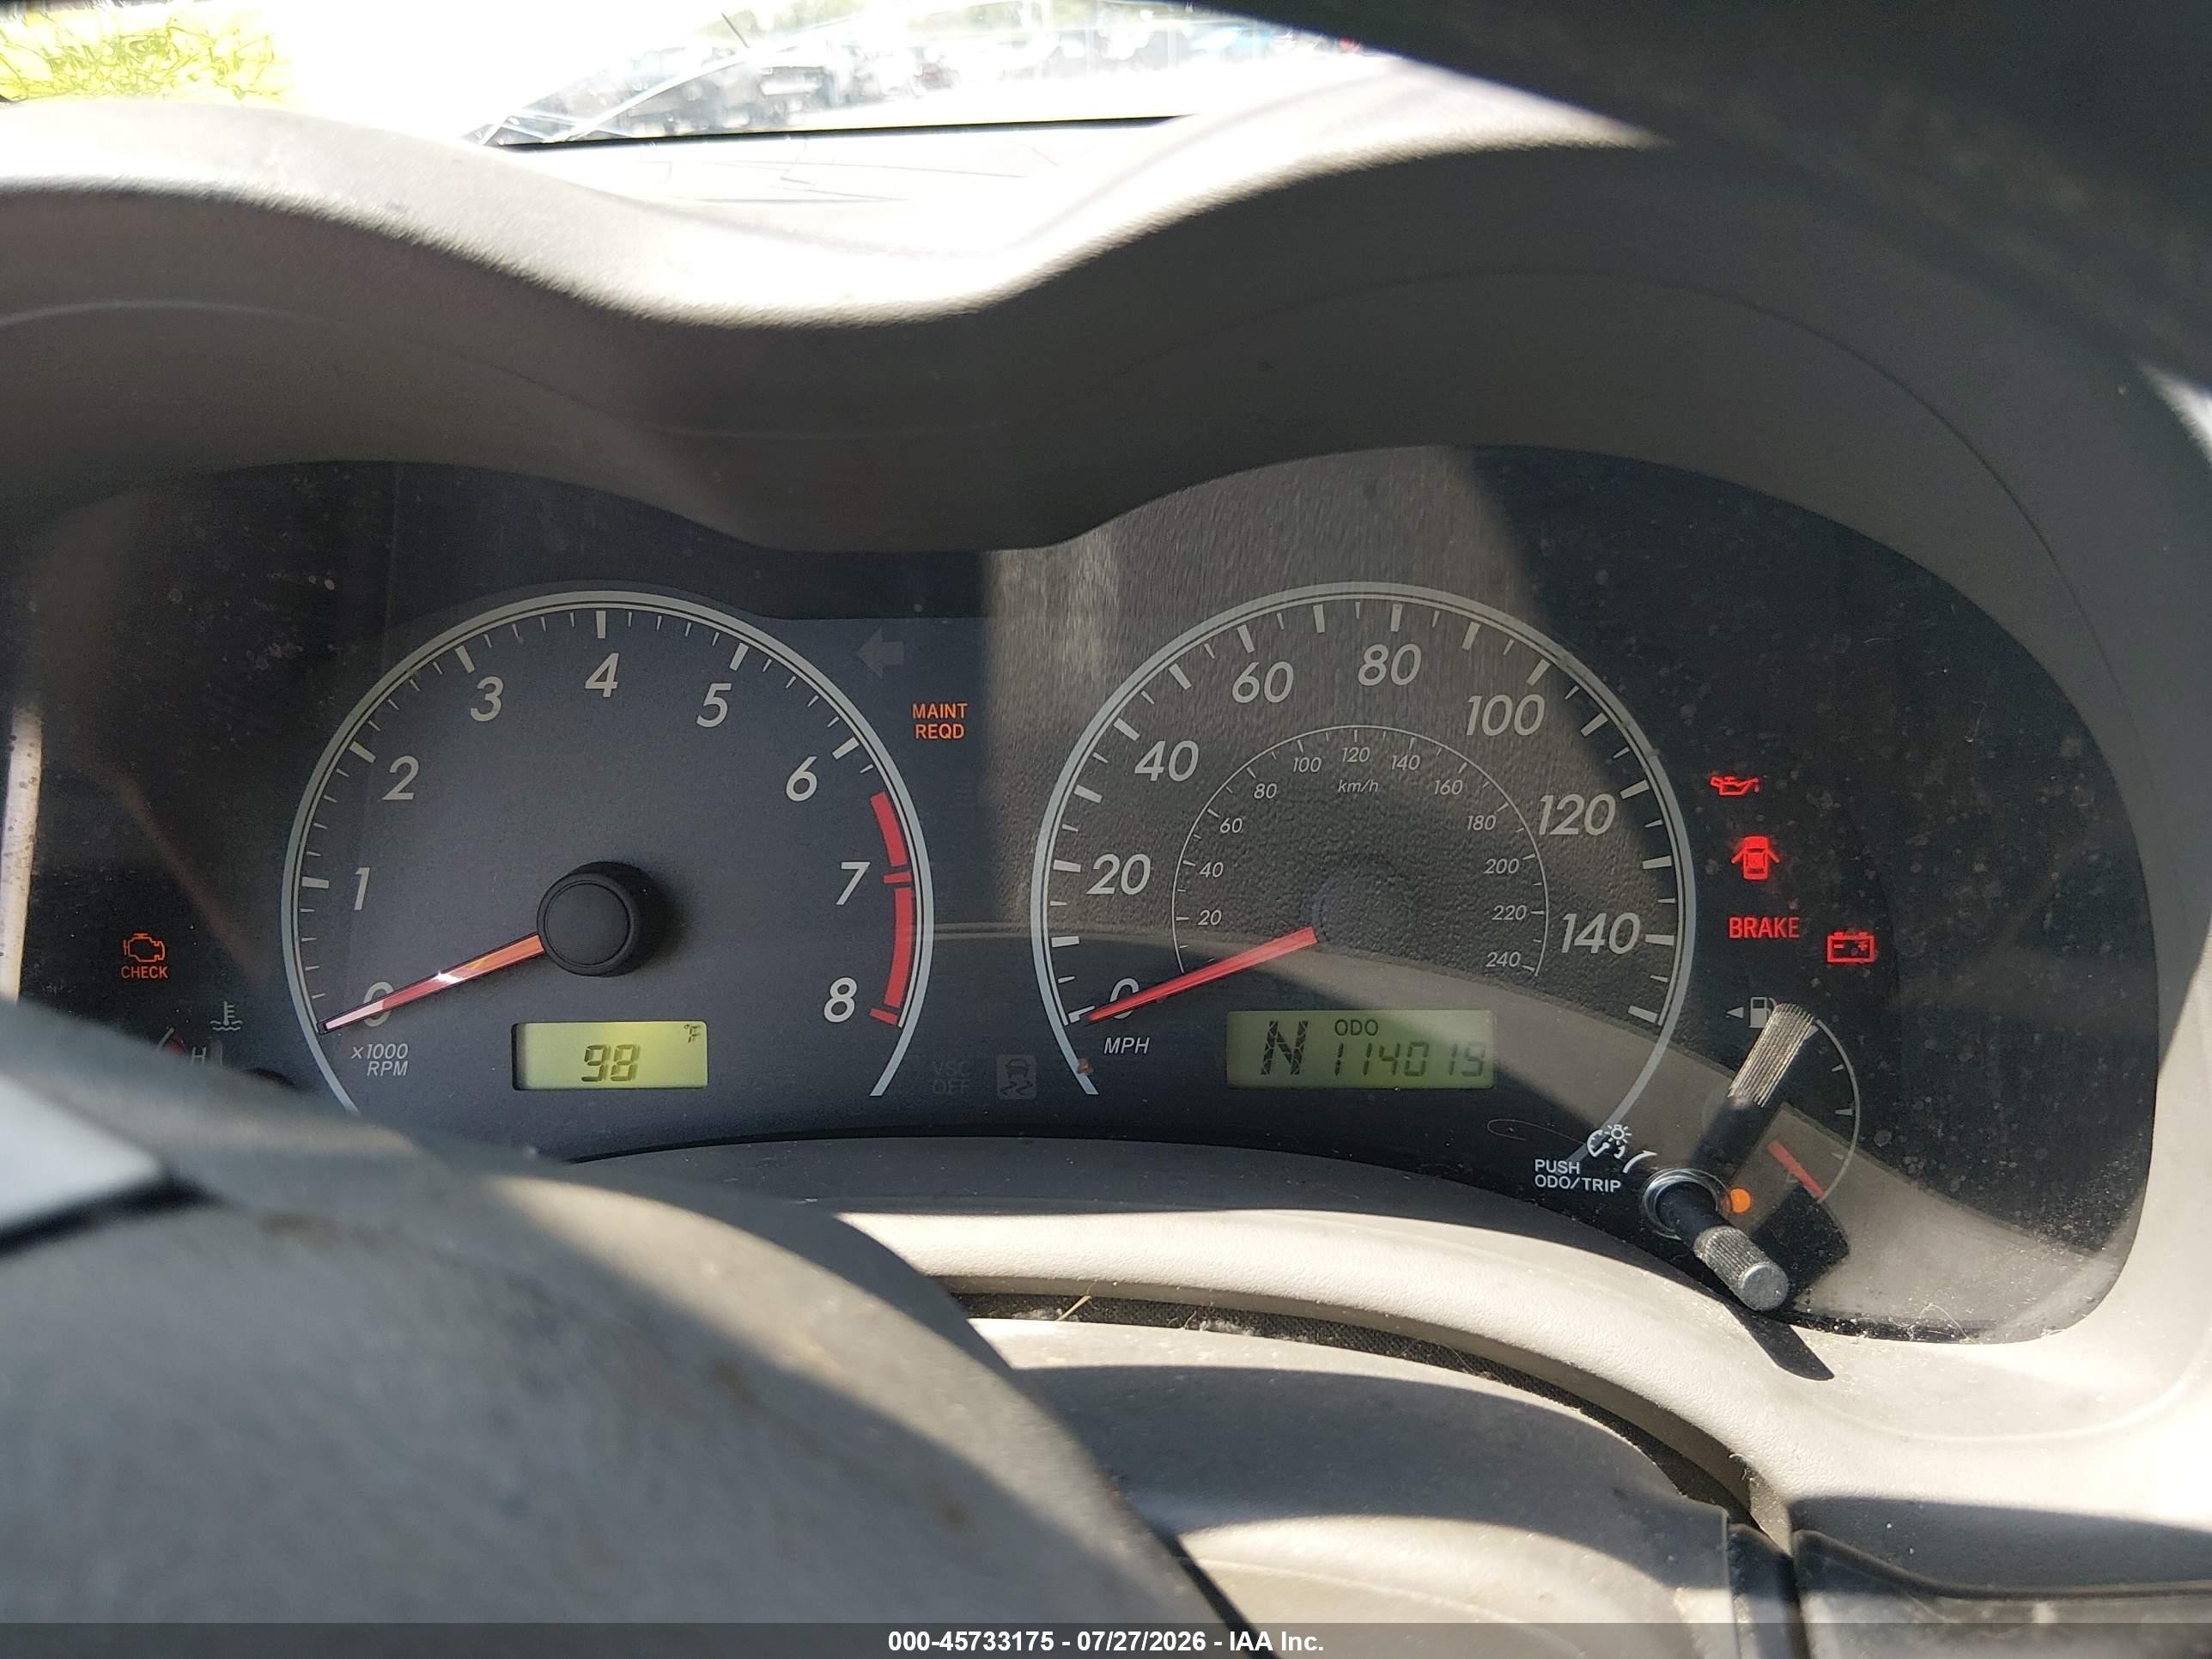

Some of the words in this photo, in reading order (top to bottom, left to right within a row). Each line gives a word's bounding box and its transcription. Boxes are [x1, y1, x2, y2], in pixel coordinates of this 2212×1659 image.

[1358, 643, 1421, 686] 80
[585, 652, 620, 698] 4
[1231, 661, 1294, 704] 60
[470, 676, 503, 722] 3
[696, 683, 732, 728] 5
[912, 702, 968, 720] MAINT
[1466, 694, 1545, 737] 100
[915, 723, 964, 739] REQD
[1134, 740, 1199, 781] 40
[1342, 747, 1370, 763] 120
[1391, 755, 1420, 770] 140
[1292, 757, 1322, 773] 100
[383, 756, 419, 800] 2
[784, 757, 818, 802] 6
[1338, 779, 1378, 793] km/h
[1254, 783, 1277, 799] 80
[1435, 780, 1463, 795] 160
[1467, 815, 1497, 830] 180
[1538, 793, 1616, 836] 120
[1219, 817, 1243, 833] 60
[1086, 854, 1151, 896] 20
[1199, 861, 1224, 879] 40
[1484, 858, 1519, 874] 200
[353, 867, 370, 910] 1
[836, 861, 869, 906] 7
[1198, 909, 1222, 926] 20
[1492, 904, 1527, 921] 220
[1561, 912, 1640, 954] 140
[1729, 916, 1801, 939] BRAKE
[1486, 951, 1521, 967] 240
[120, 965, 169, 980] CHECK
[363, 981, 394, 1027] 0
[823, 977, 857, 1024] 8
[1109, 978, 1139, 1019] 0
[1334, 1019, 1379, 1036] ODO
[1103, 1036, 1151, 1054] MPH
[1261, 1020, 1308, 1075] N
[367, 1060, 408, 1076] RPM
[581, 1044, 640, 1082] 98
[1534, 1159, 1580, 1174] PUSH
[1534, 1176, 1621, 1192] ODO/TRIP
